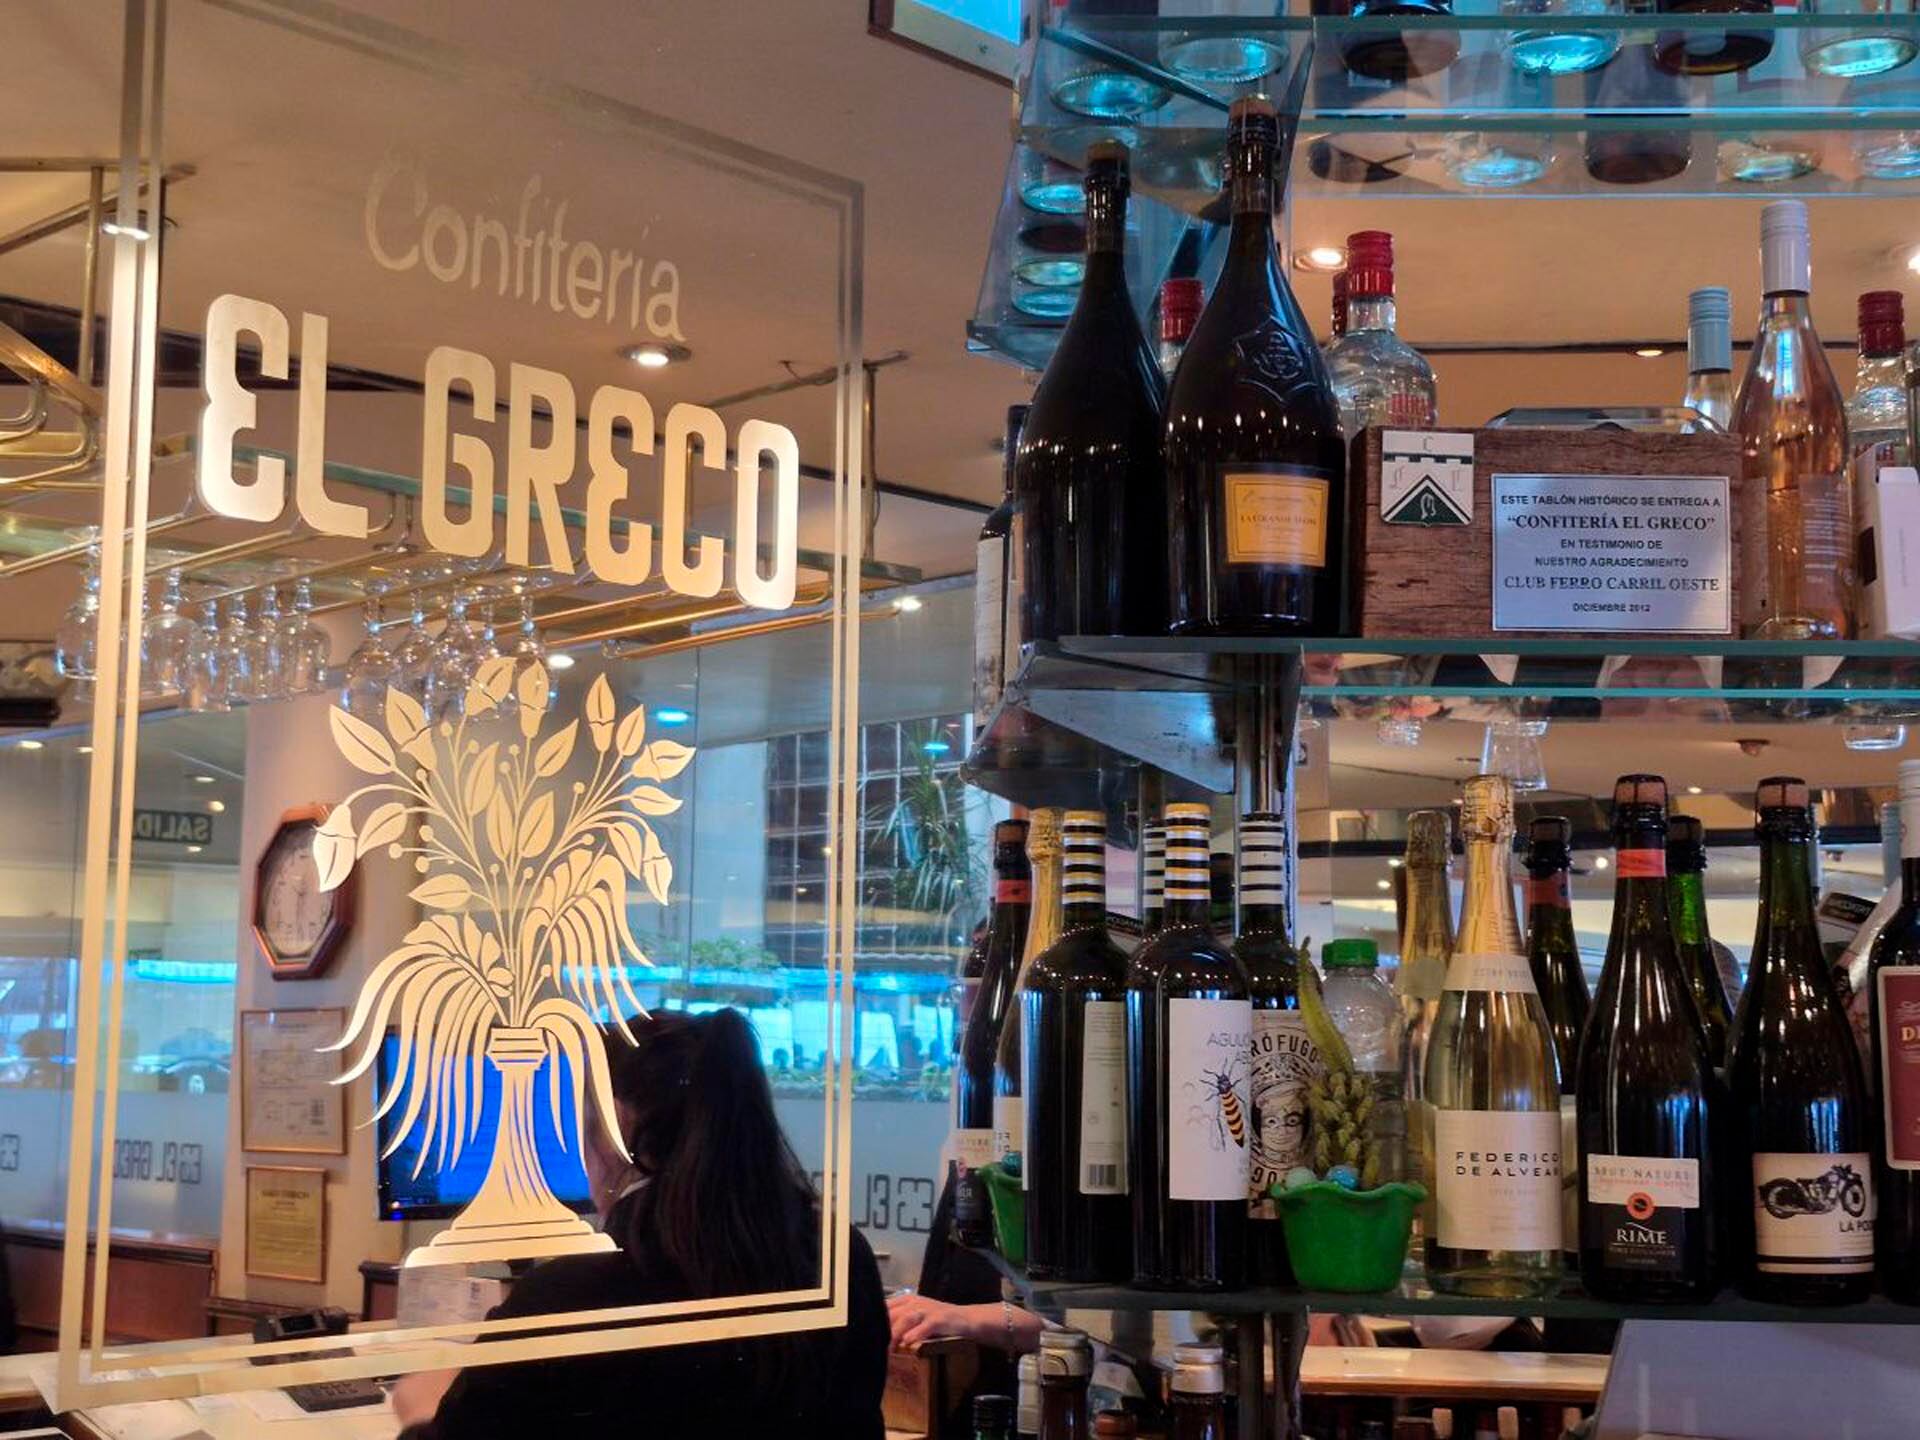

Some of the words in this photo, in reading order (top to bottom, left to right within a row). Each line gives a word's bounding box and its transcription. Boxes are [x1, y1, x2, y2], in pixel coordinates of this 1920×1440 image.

[366, 148, 686, 342] Confitería
[200, 294, 368, 539] EL
[421, 346, 799, 611] GRECO
[1501, 496, 1528, 505] ESTE
[1532, 494, 1576, 505] TABLÓN
[1578, 494, 1637, 506] HISTÓRICO
[1641, 497, 1654, 506] SE
[1658, 498, 1709, 507] ENTREGA
[1712, 499, 1720, 507] A
[1623, 517, 1644, 529] EL
[1561, 540, 1575, 549] EN
[1579, 540, 1644, 549] TESTIMONIO
[1648, 540, 1662, 549] DE
[1535, 557, 1587, 567] NUESTRO
[1590, 558, 1689, 568] AGRADECIMIENTO
[1504, 576, 1545, 589] CLUB
[1550, 577, 1602, 590] FERRO
[1606, 577, 1666, 590] CARRIL
[1669, 578, 1719, 591] OESTE
[1573, 603, 1626, 612] DICIEMBRE
[1629, 603, 1650, 612] 2012
[1251, 1032, 1318, 1064] RÓFUGO
[1456, 1151, 1559, 1163] FEDERICO
[1456, 1166, 1480, 1177] DE
[1840, 1221, 1855, 1233] LA
[1616, 1224, 1668, 1245] RIME
